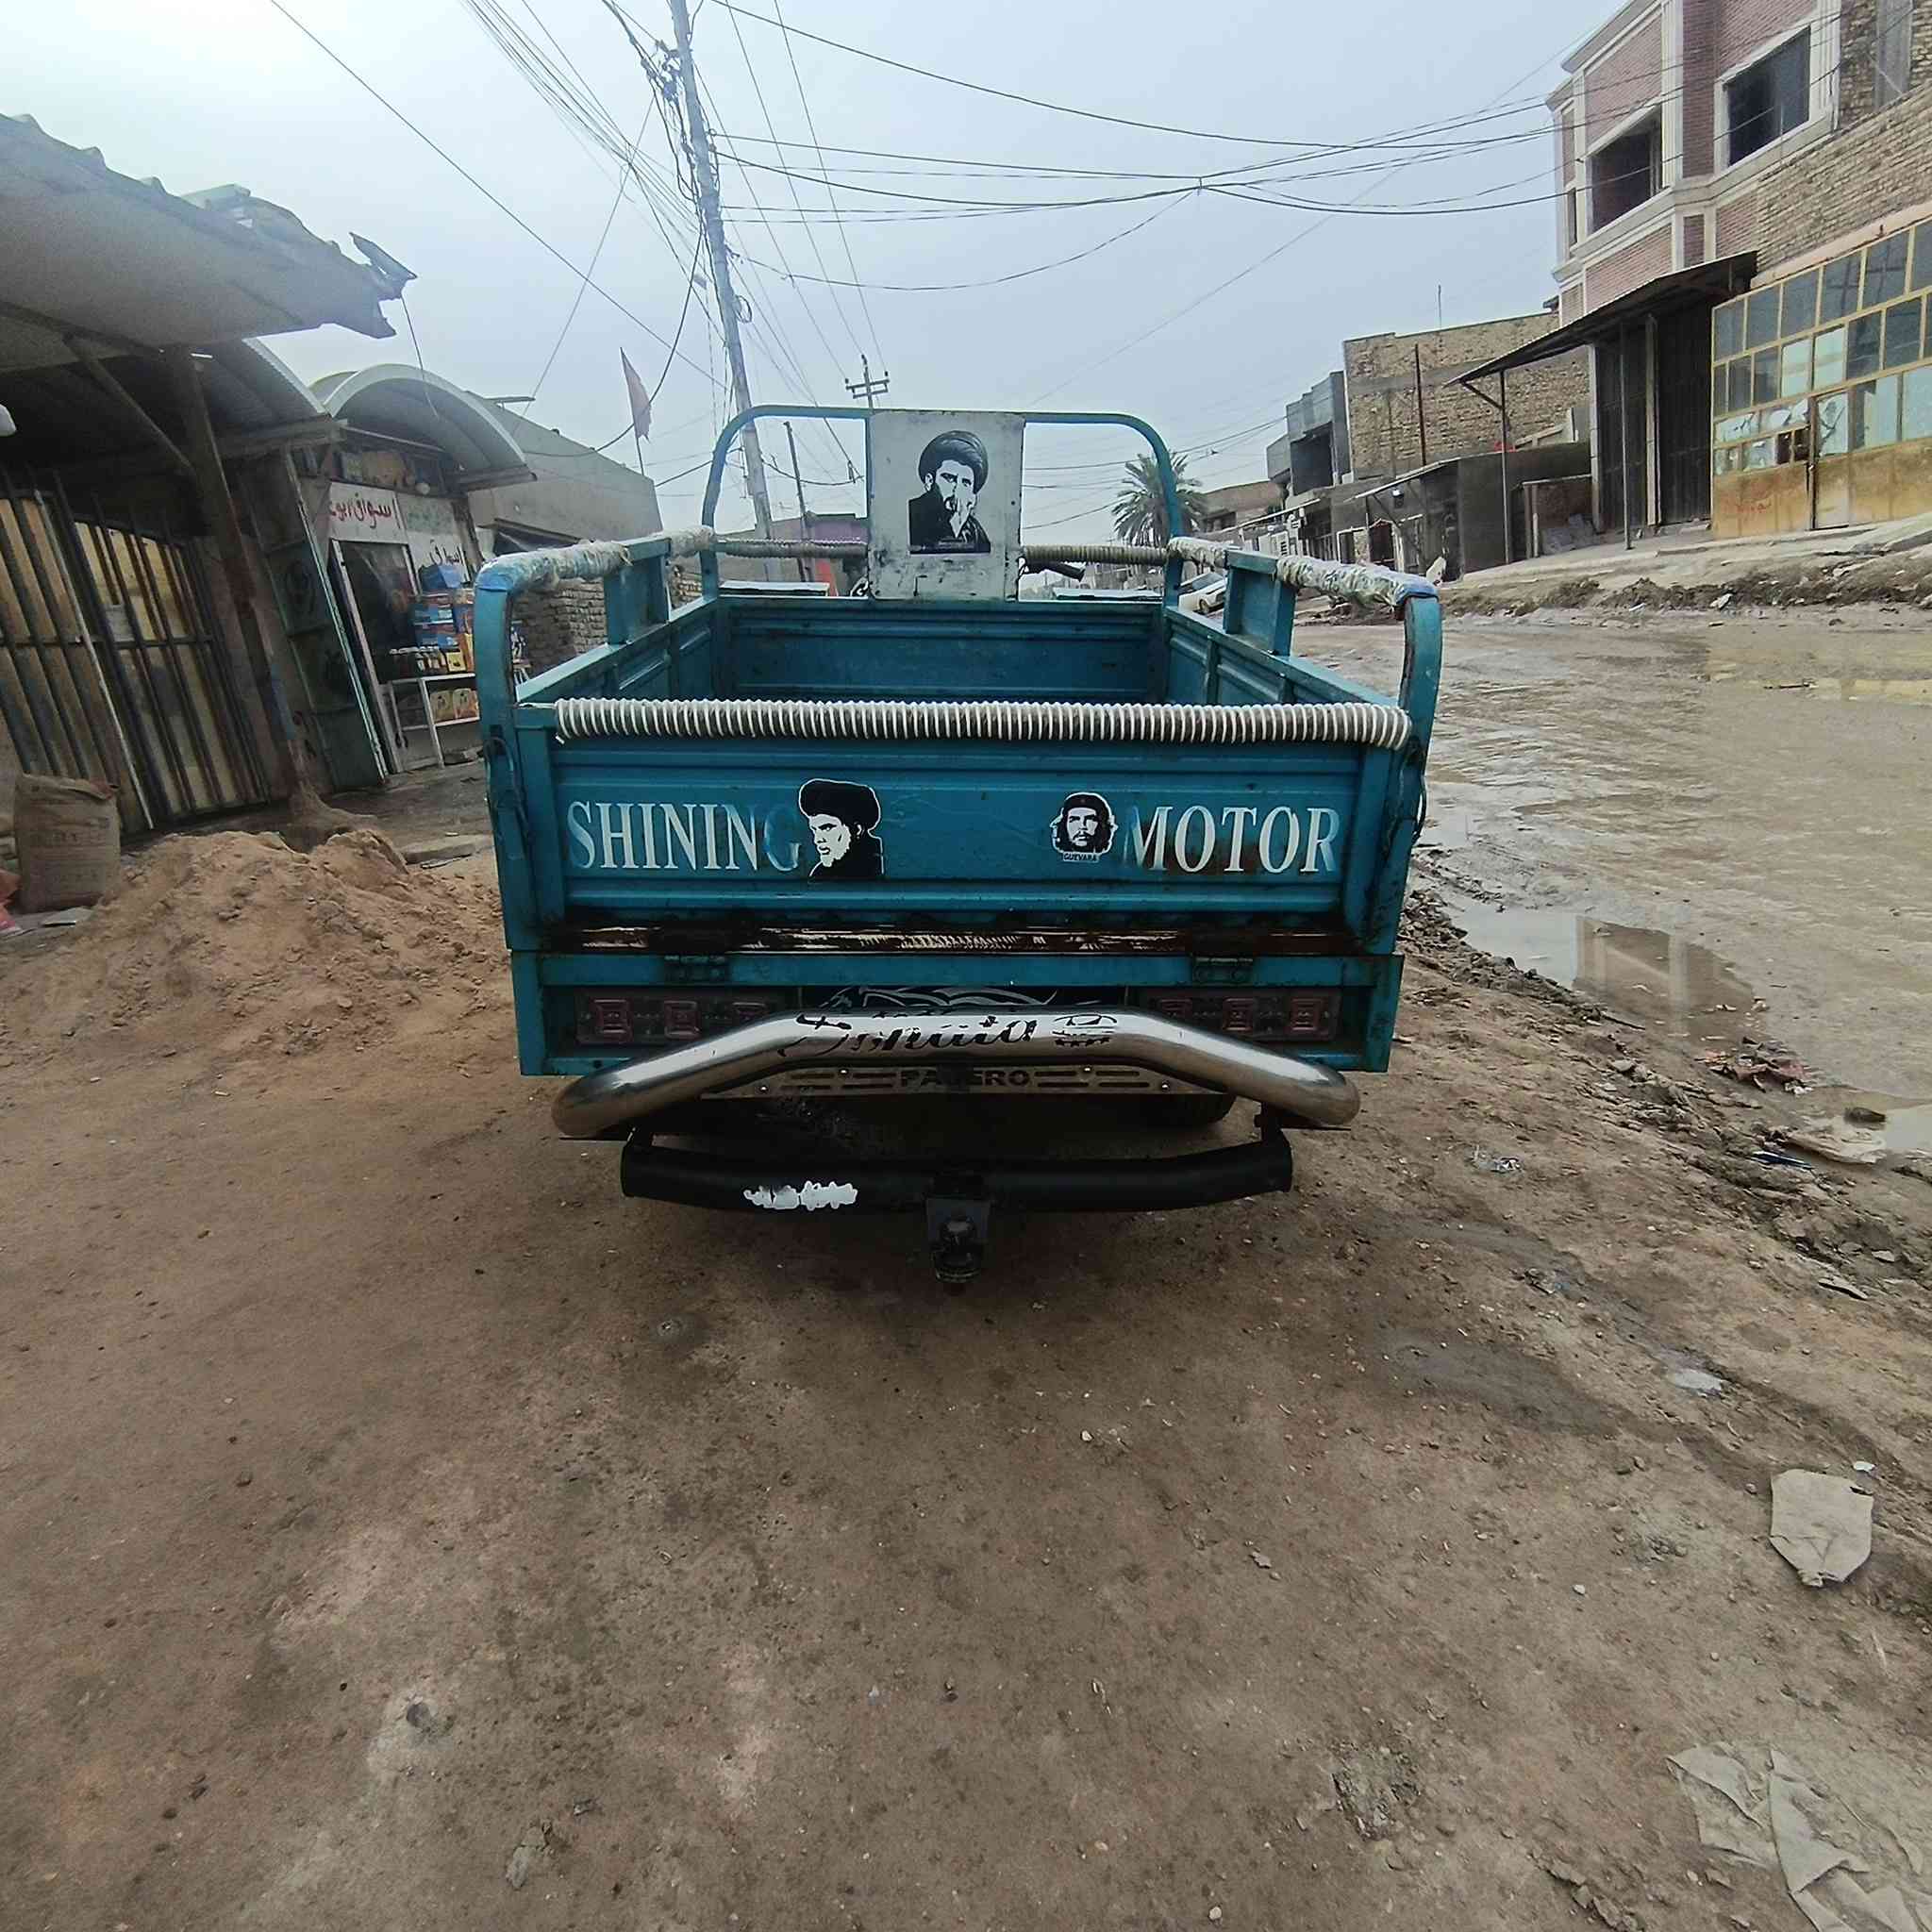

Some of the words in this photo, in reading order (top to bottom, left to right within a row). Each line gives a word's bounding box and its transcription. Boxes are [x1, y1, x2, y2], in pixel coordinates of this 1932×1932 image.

[567, 801, 801, 873] SHINING
[1124, 805, 1340, 874] MOTOR
[1063, 853, 1097, 861] GUEVARA
